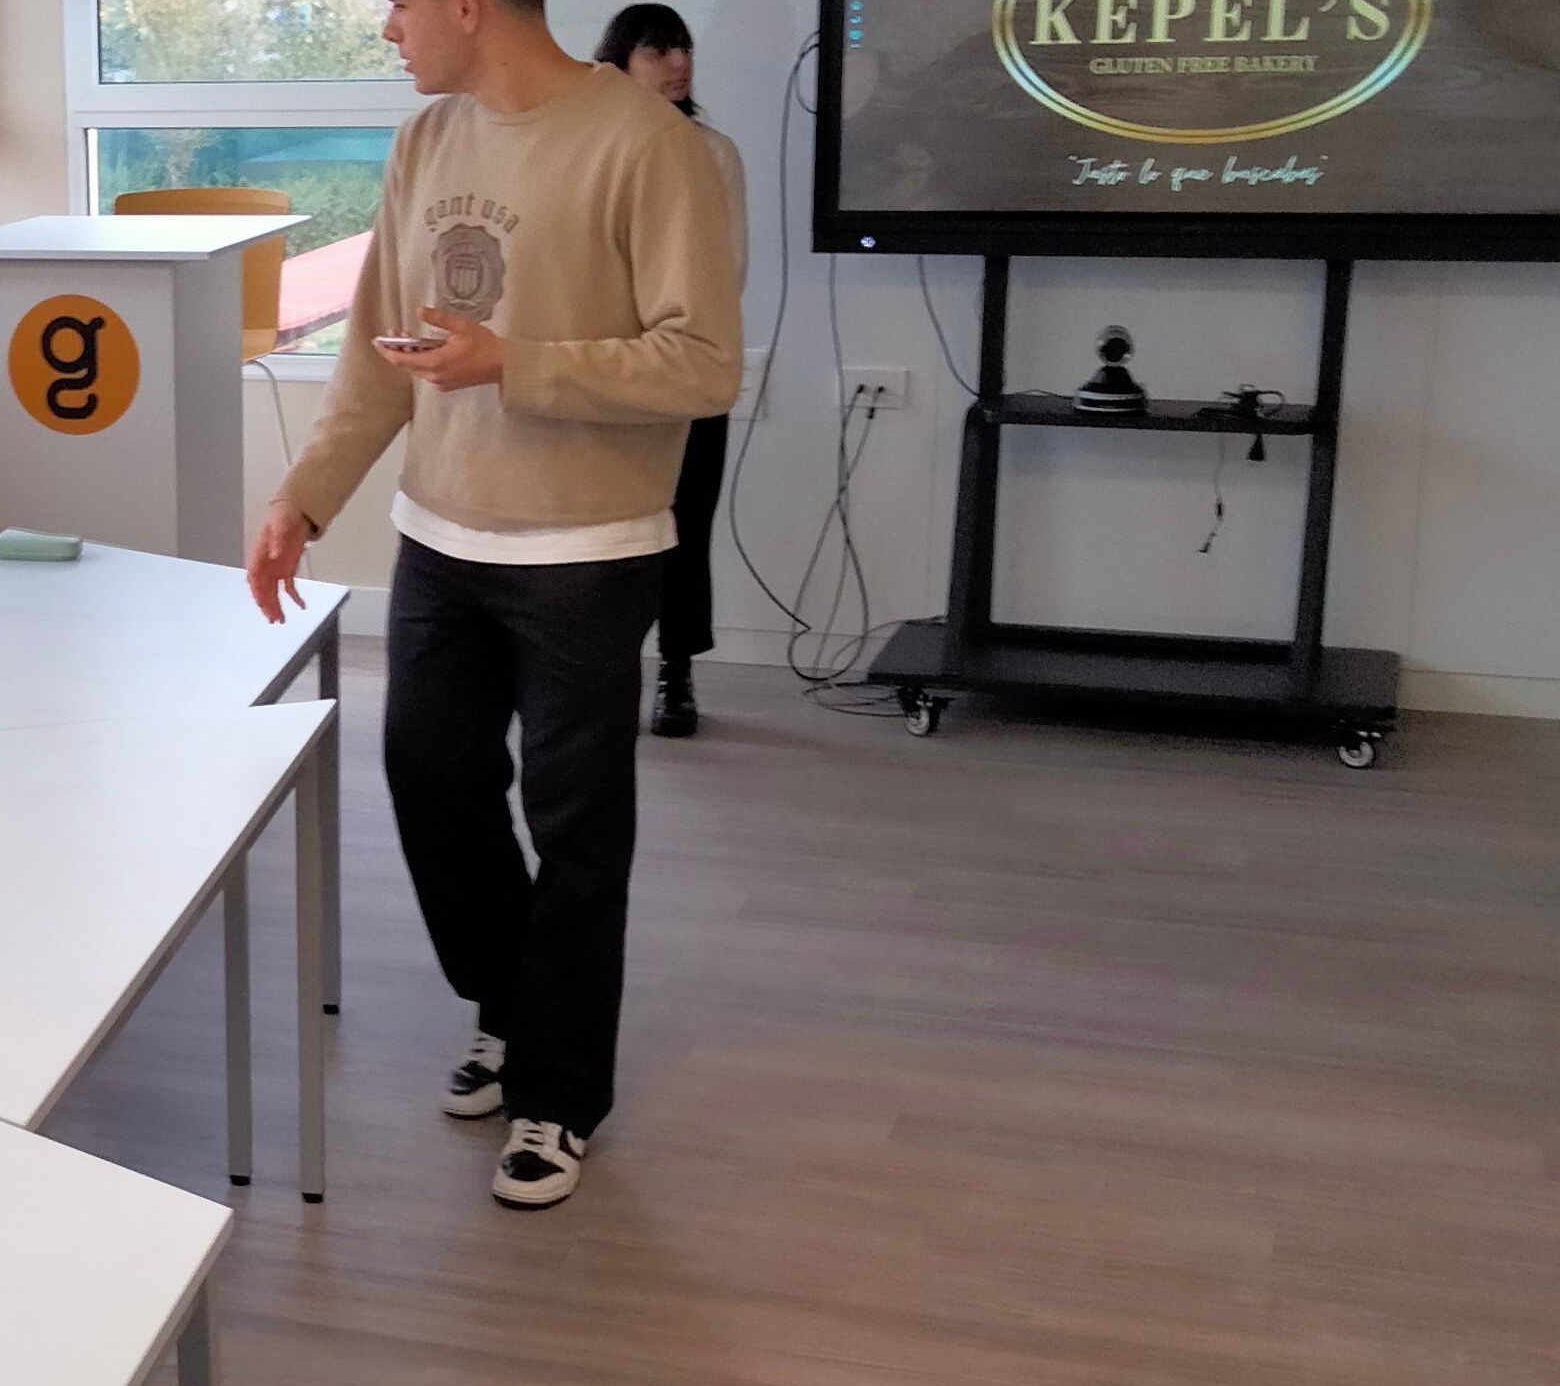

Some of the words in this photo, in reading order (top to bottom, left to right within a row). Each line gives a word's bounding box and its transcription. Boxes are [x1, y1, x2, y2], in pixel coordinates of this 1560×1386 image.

[1090, 56, 1174, 75] GLUTEN
[1177, 55, 1232, 74] FREE
[1234, 54, 1319, 73] BAKERY
